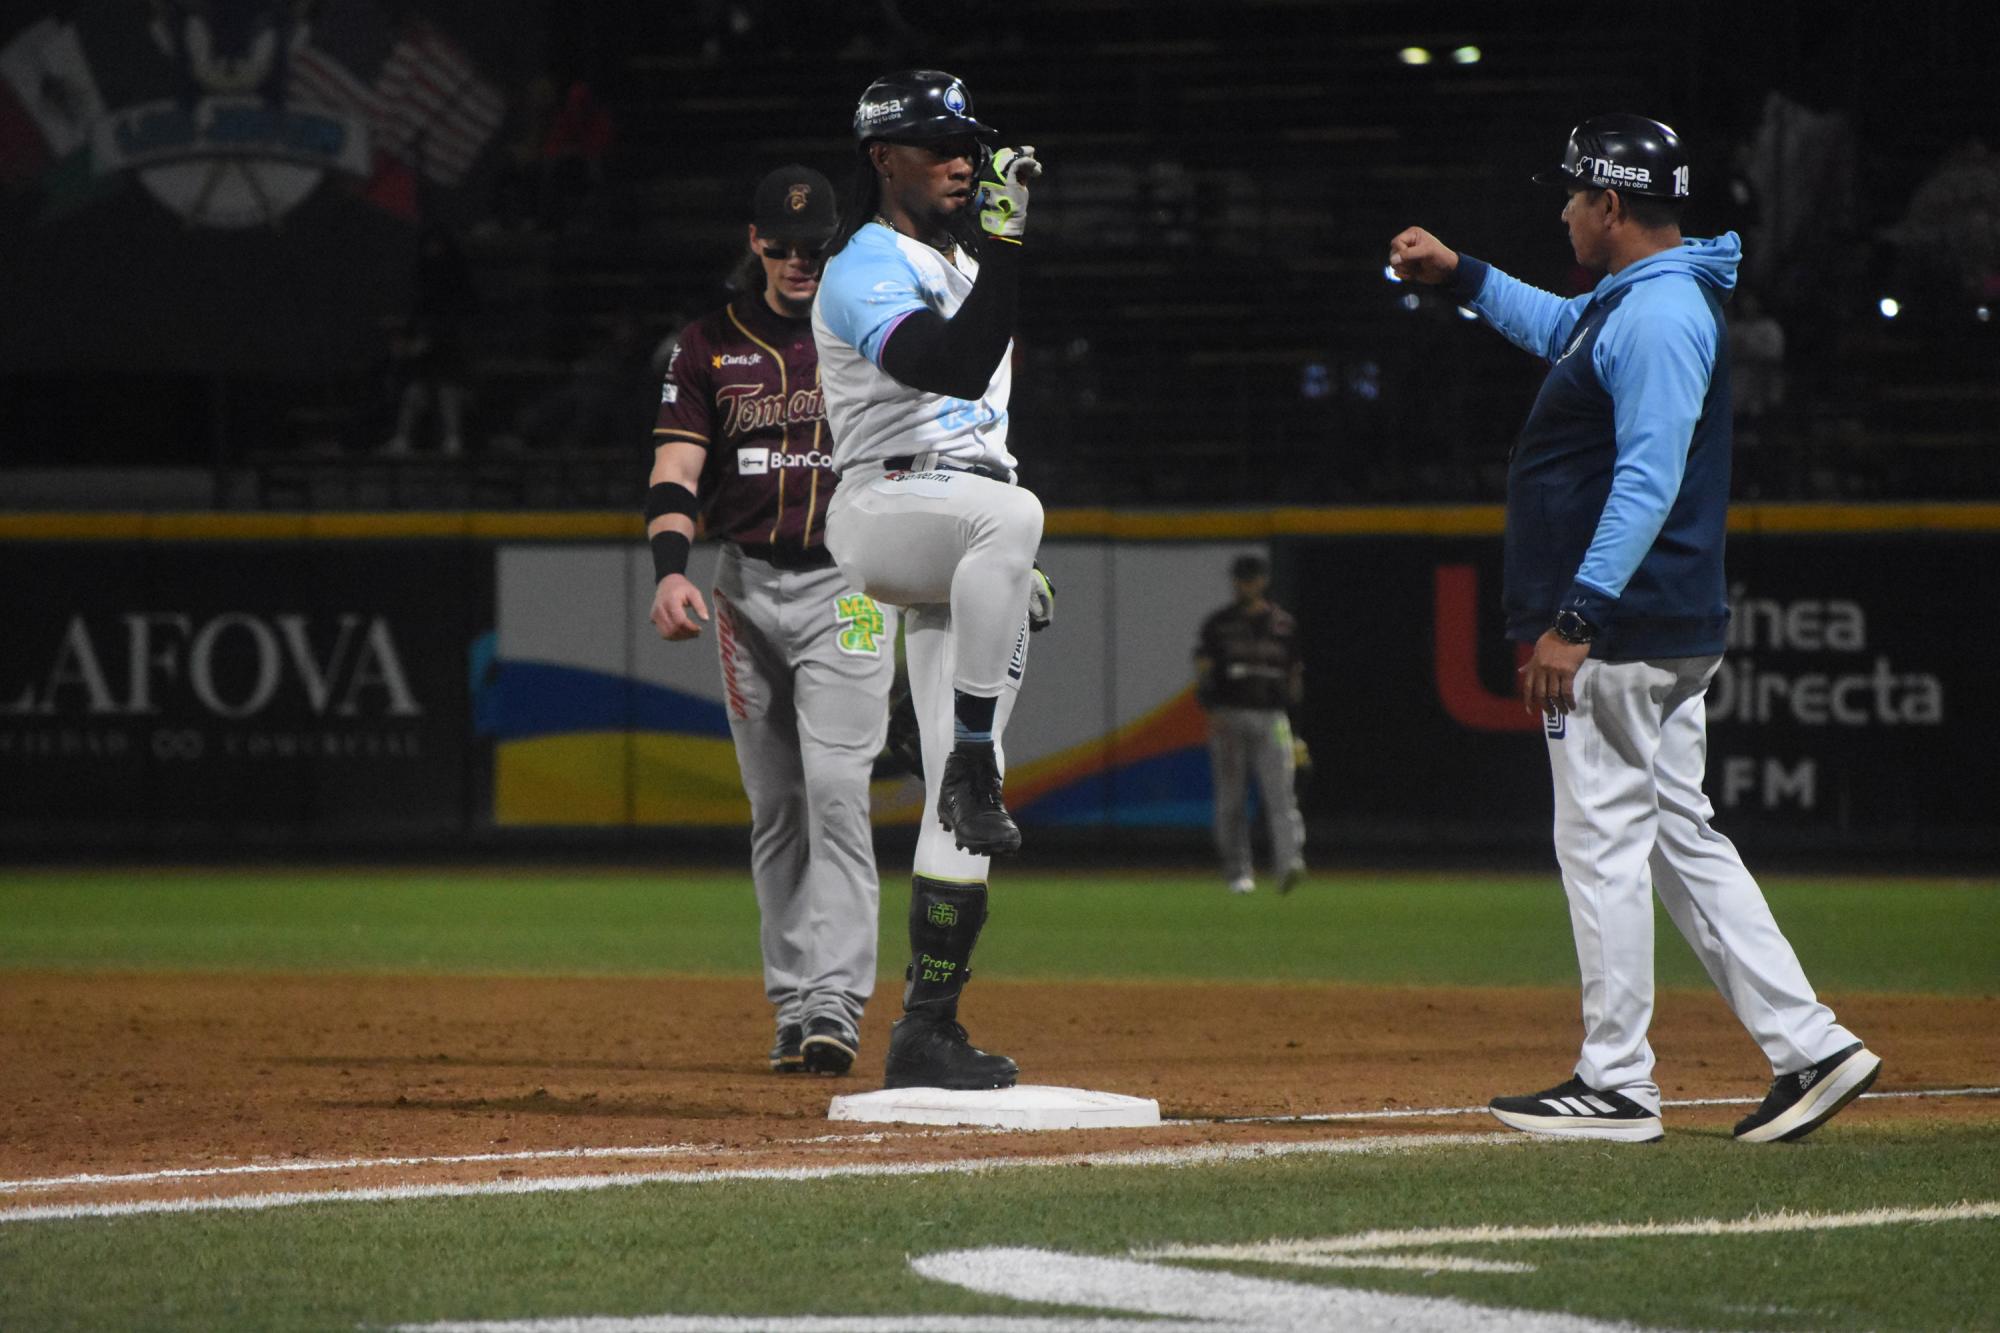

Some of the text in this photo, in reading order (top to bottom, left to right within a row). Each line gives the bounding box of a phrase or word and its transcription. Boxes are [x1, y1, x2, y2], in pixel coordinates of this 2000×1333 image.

[1632, 181, 1648, 189] obra
[1672, 165, 1690, 195] 19
[715, 382, 829, 438] Tomat
[770, 451, 833, 469] BanCo
[1721, 758, 1816, 807] FM
[921, 954, 957, 970] Proto
[922, 969, 953, 983] DLT
